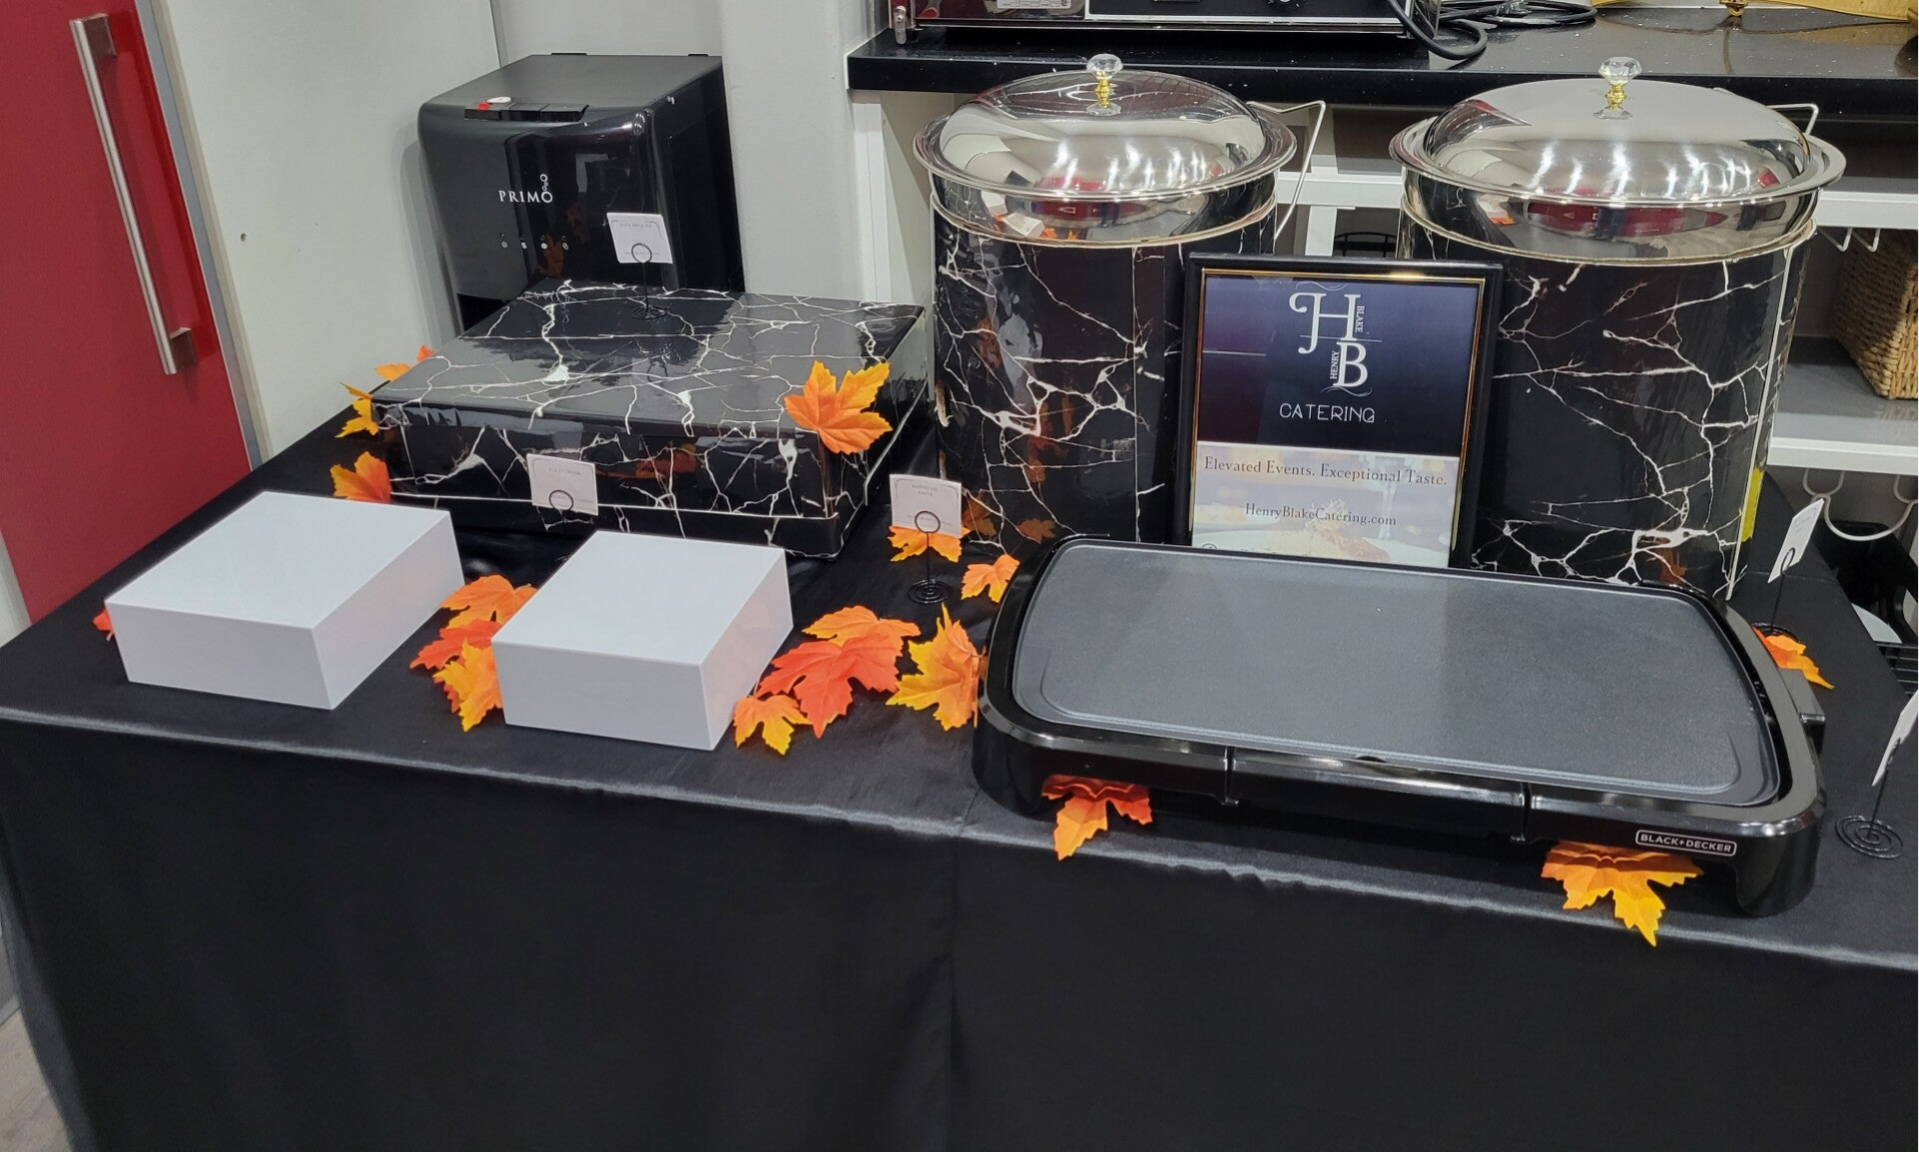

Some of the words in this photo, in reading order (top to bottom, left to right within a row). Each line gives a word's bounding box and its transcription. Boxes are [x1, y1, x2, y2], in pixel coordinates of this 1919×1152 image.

[498, 189, 553, 203] PRIMO
[1355, 305, 1365, 333] BLAKE
[1329, 350, 1340, 380] HENRY
[1333, 341, 1368, 387] B
[1279, 403, 1375, 423] CATERING
[1204, 456, 1262, 474] Elevated
[1266, 460, 1316, 477] Events.
[1320, 464, 1401, 483] Exceptional
[1405, 469, 1448, 486] Taste.
[1245, 503, 1397, 526] HenryBlakeCatering.com
[1640, 834, 1732, 853] BLACK+DECKER
